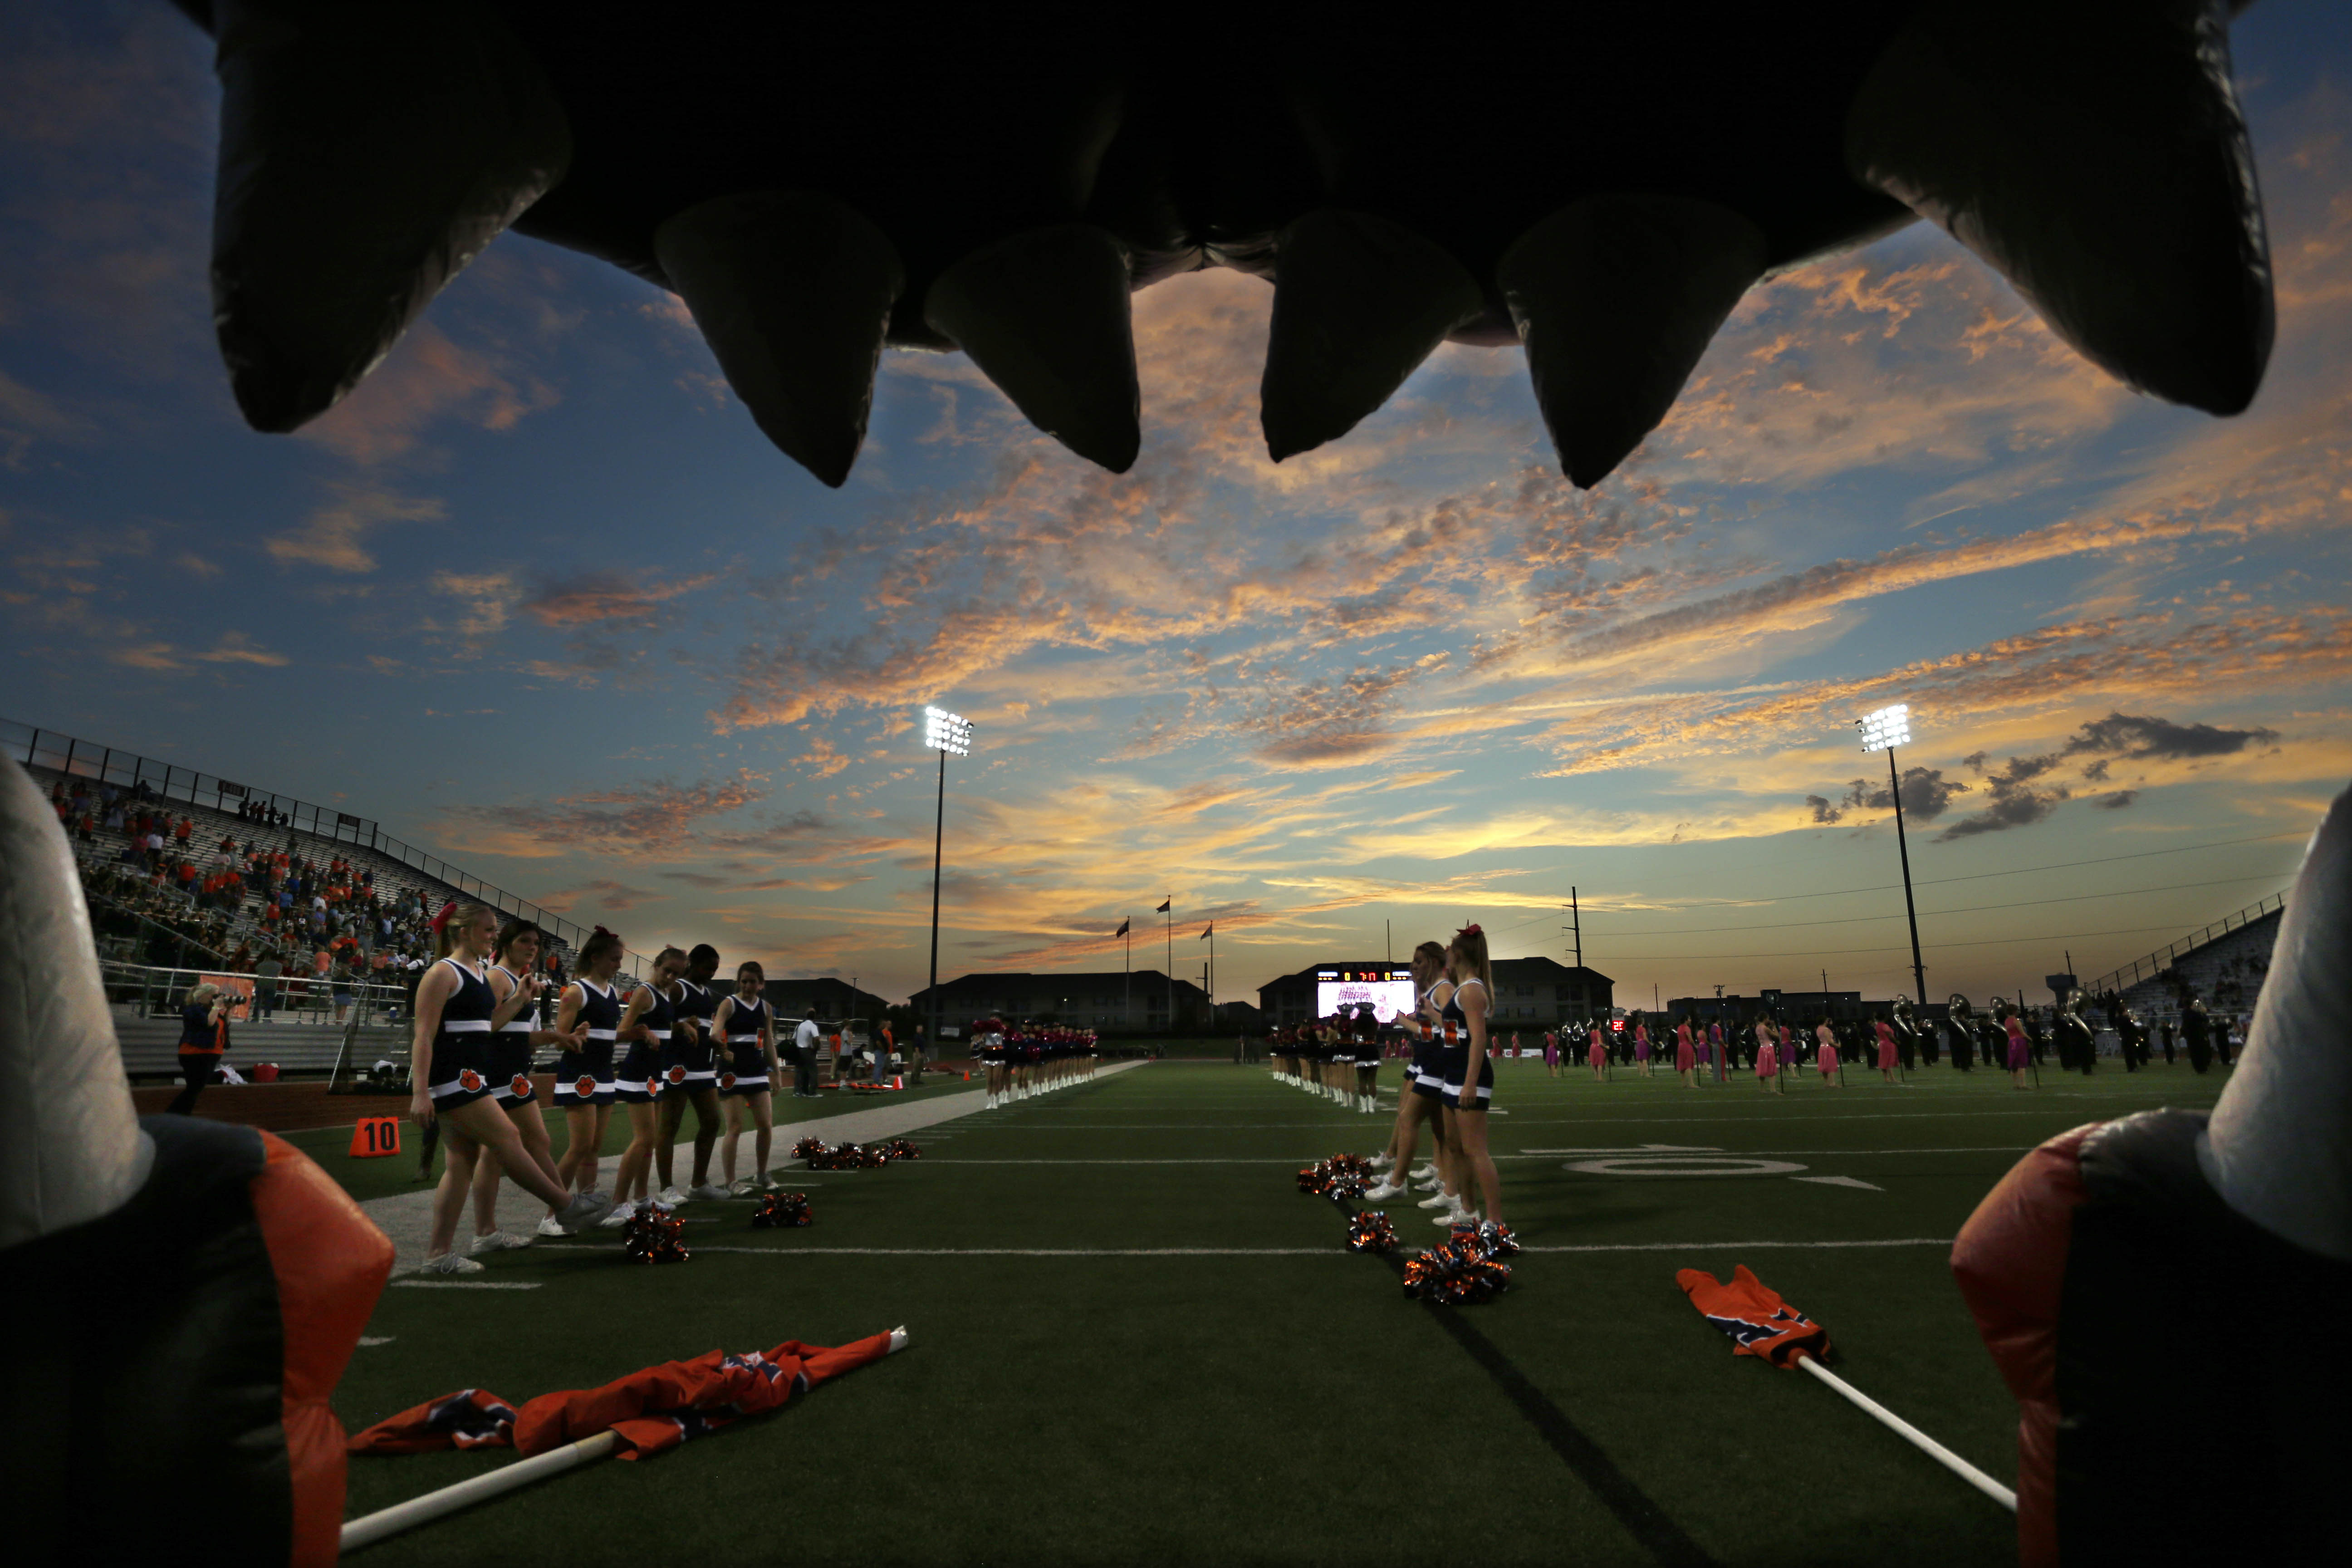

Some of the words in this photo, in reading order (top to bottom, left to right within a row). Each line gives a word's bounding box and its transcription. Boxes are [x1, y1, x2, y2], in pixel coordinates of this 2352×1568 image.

[1344, 971, 1351, 981] 0
[1359, 972, 1377, 981] 7:17
[1384, 971, 1391, 981] 0
[365, 1122, 395, 1152] 10
